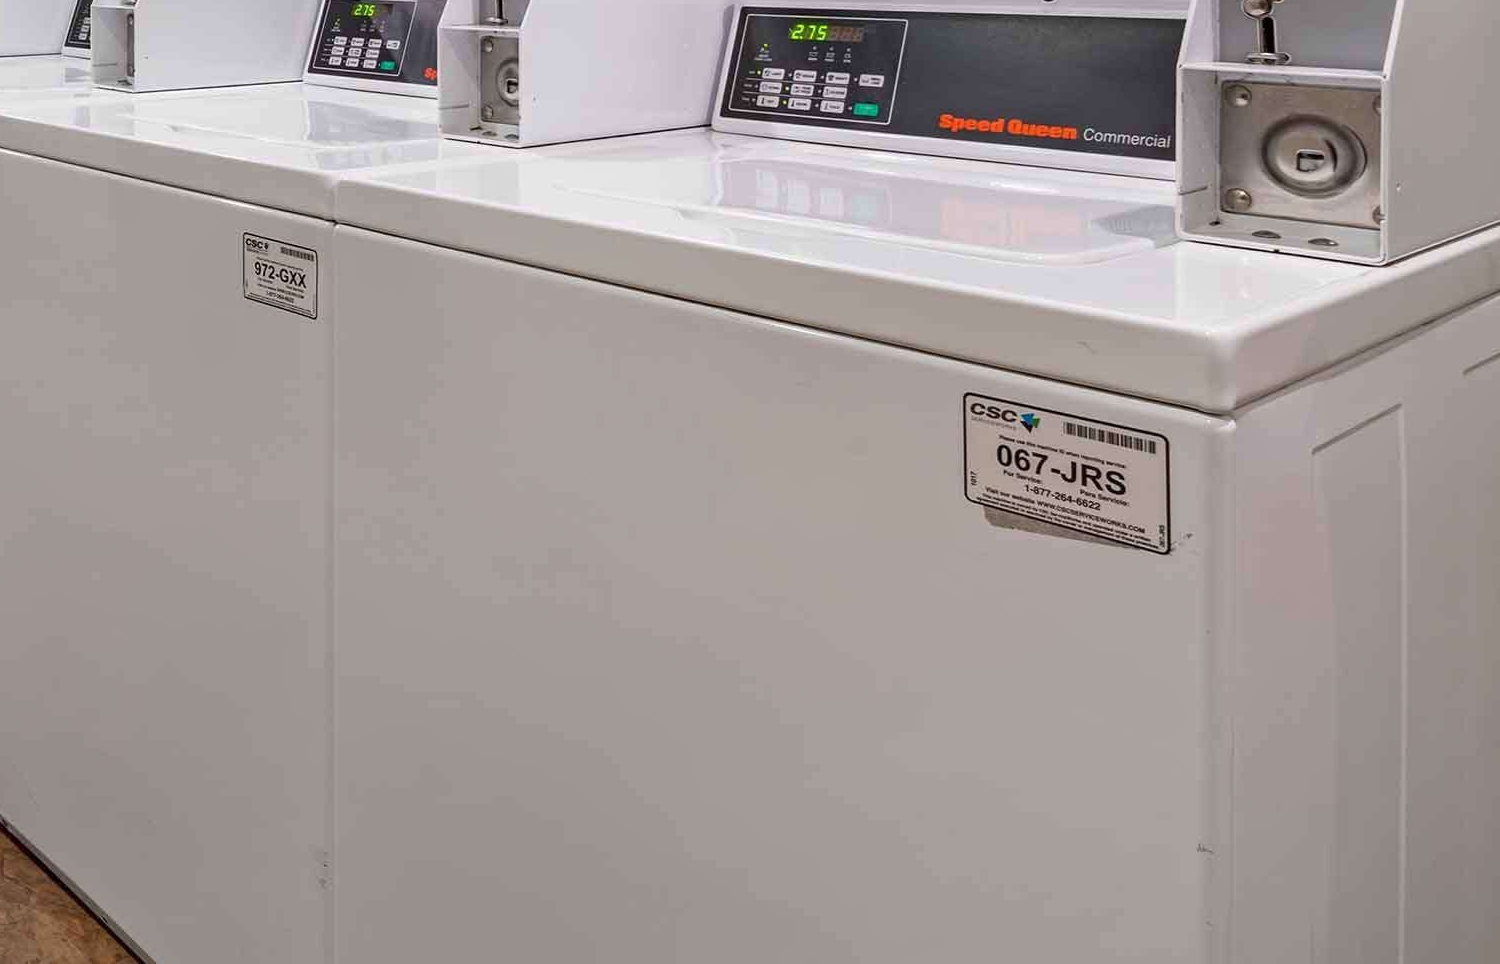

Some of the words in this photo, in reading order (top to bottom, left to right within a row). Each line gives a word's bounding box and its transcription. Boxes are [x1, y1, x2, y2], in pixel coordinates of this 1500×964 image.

[790, 24, 828, 41] 2.75
[939, 114, 1004, 132] Speed
[1007, 119, 1077, 140] Queen
[1084, 128, 1171, 148] Commercial
[246, 238, 263, 249] CSC
[254, 262, 306, 288] 972-GXX
[971, 403, 1017, 423] CSC
[997, 444, 1126, 495] 067-JRS
[1025, 484, 1100, 510] 1-877-264-6622
